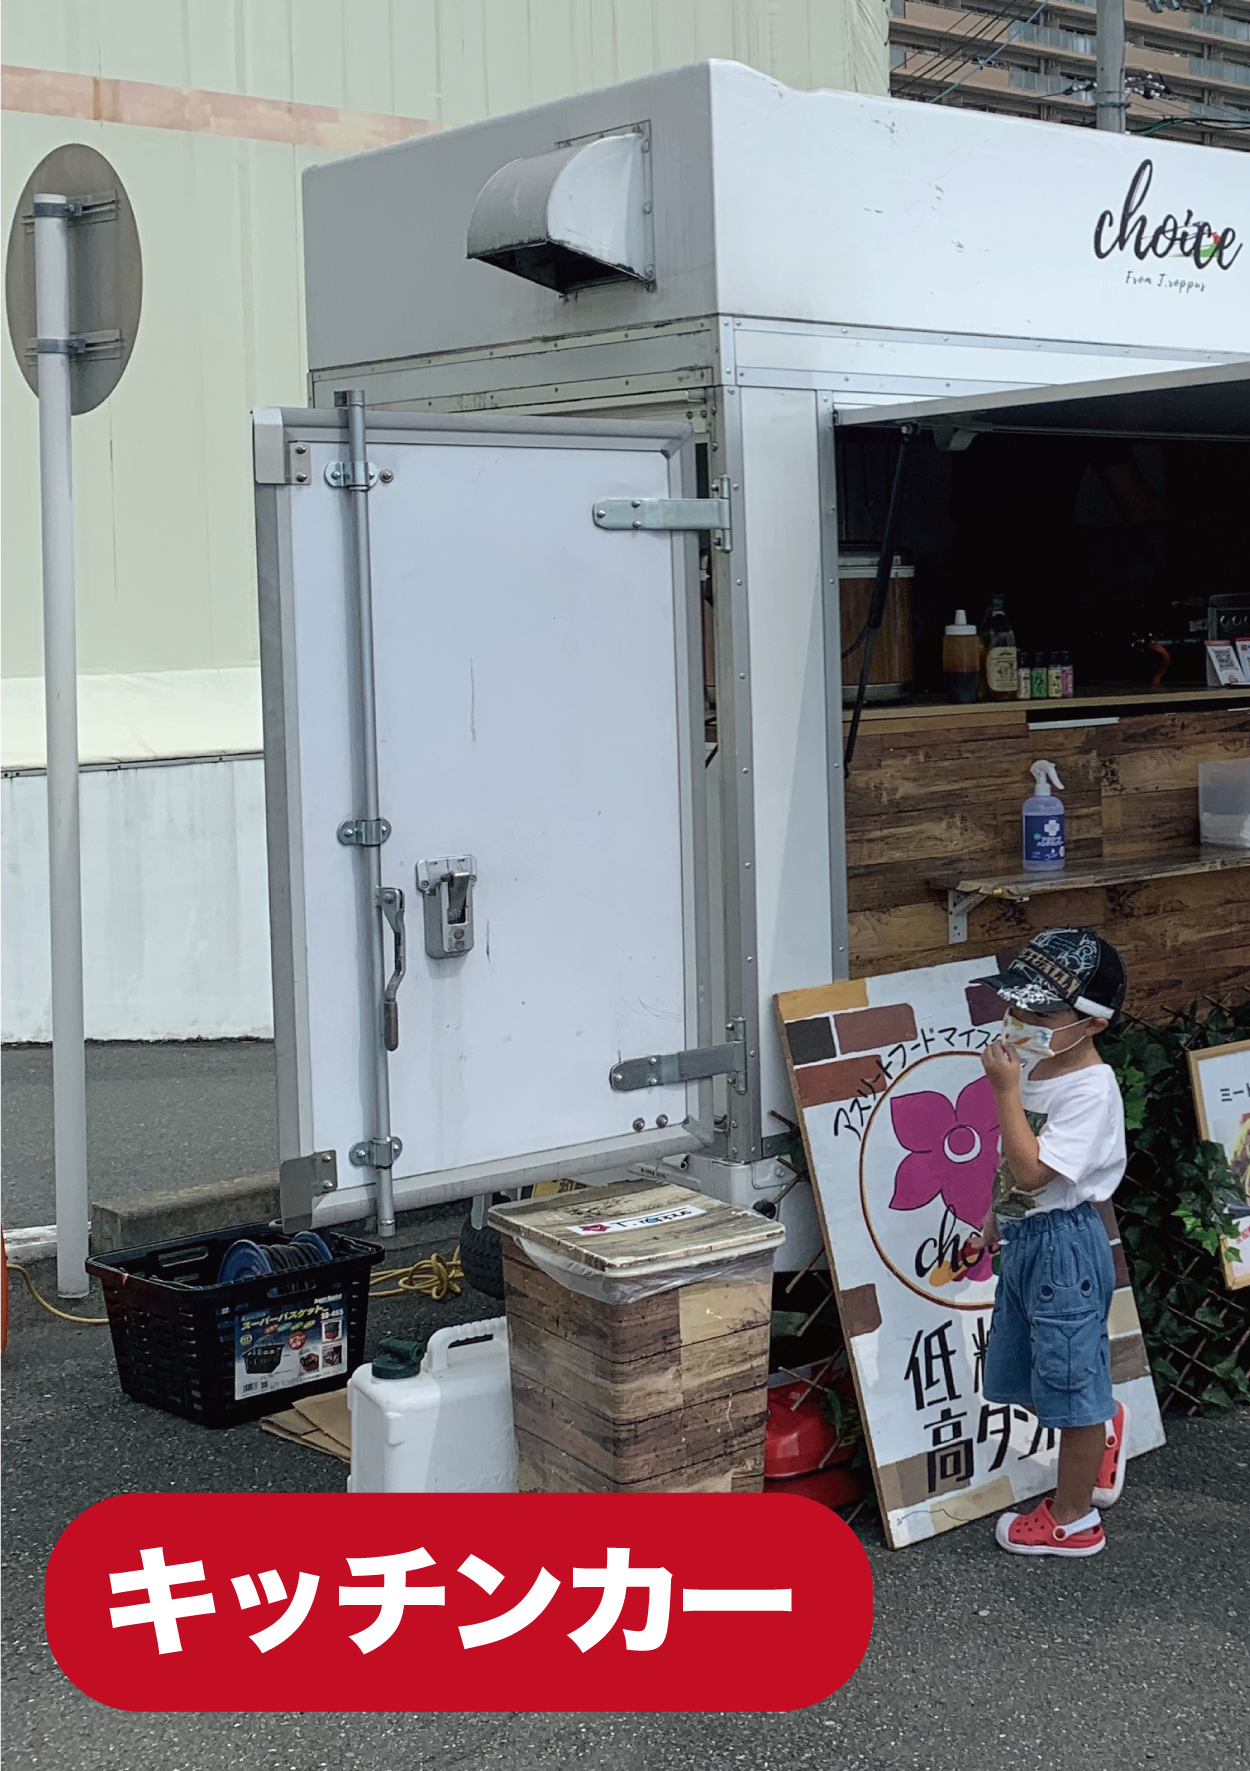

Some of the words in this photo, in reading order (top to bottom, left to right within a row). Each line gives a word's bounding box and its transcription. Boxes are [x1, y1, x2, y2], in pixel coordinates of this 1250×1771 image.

[1094, 158, 1244, 271] choice
[834, 1026, 1002, 1141] アスリートフードマイス
